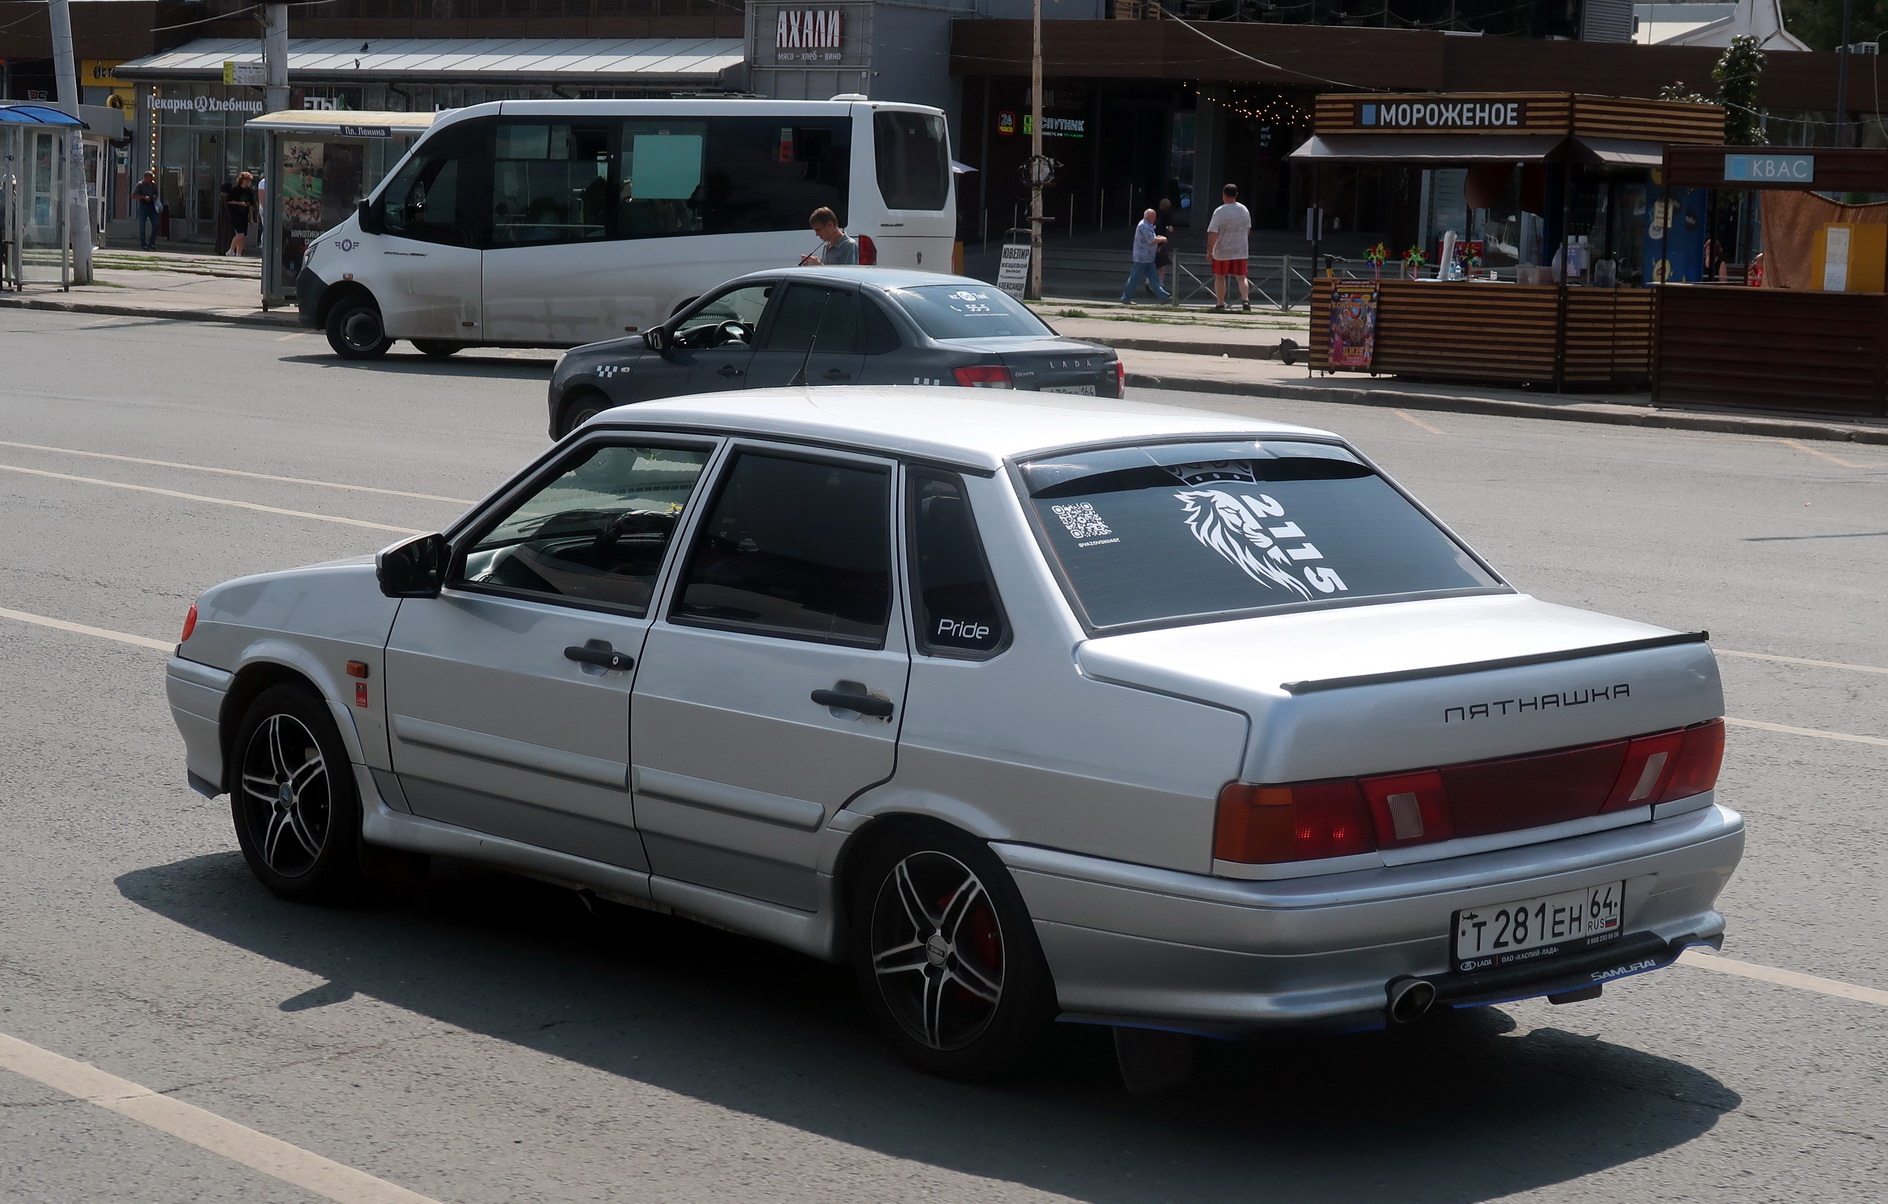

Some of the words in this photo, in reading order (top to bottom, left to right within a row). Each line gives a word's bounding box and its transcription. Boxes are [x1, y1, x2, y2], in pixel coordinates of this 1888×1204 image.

[776, 10, 840, 48] АХАЛИ
[777, 52, 794, 60] мясо
[801, 50, 817, 60] хлеб
[824, 52, 841, 60] вино
[147, 95, 193, 113] Пекарня
[209, 98, 263, 114] Хлебница
[1380, 103, 1519, 126] МОРОЖЕНОЕ
[344, 126, 357, 136] Пл.
[358, 127, 386, 136] Ленина
[1753, 159, 1808, 178] КВАС
[1049, 360, 1092, 369] LADA
[1239, 493, 1349, 594] 2115
[937, 618, 990, 640] Pride
[1444, 683, 1630, 723] ПЯТНАШКА
[1590, 886, 1613, 918] 64
[1587, 919, 1606, 931] RUS
[1476, 958, 1492, 968] LADA
[1590, 959, 1656, 982] SAMURAI
